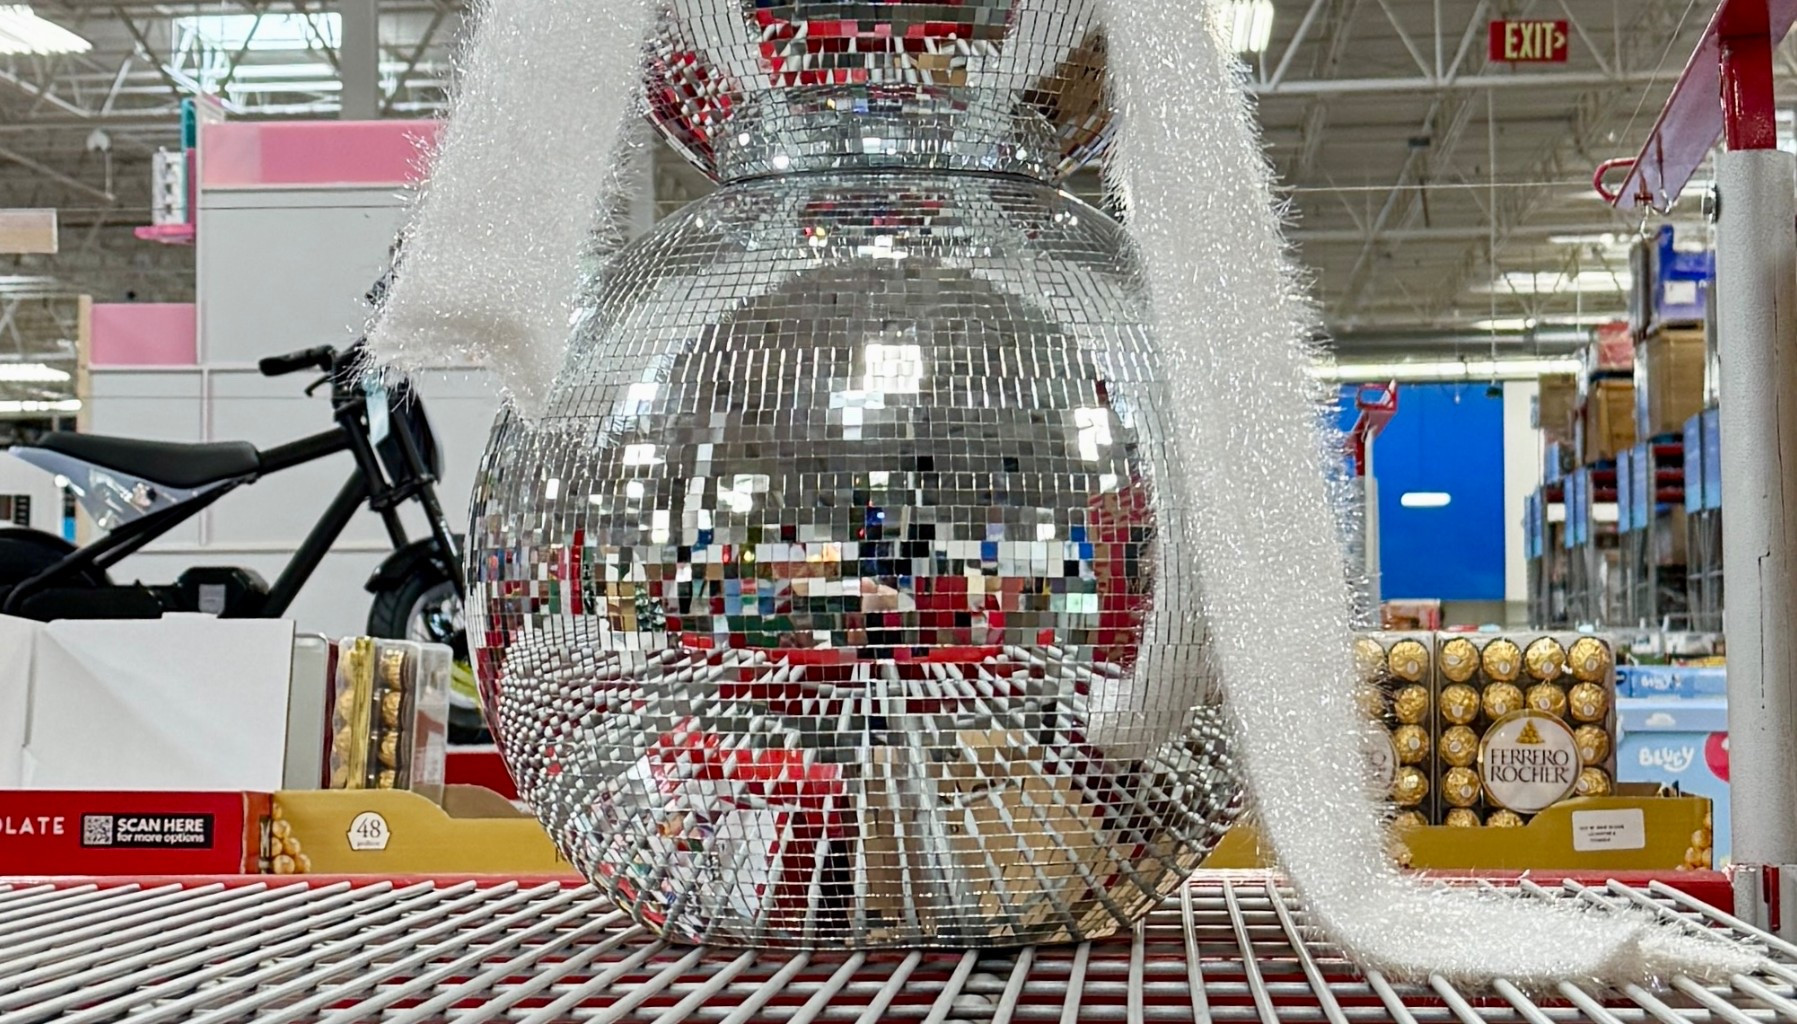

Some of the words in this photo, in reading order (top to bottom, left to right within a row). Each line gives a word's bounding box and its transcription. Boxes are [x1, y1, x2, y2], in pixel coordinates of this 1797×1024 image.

[1505, 22, 1555, 58] EXIT
[1490, 748, 1569, 766] FERRERO
[1490, 766, 1568, 784] ROCHER
[0, 816, 65, 835] LATE
[117, 818, 161, 832] SCAN
[163, 818, 204, 832] HERE
[356, 816, 381, 838] 48
[117, 832, 133, 842] for
[134, 833, 163, 842] more
[163, 832, 205, 845] options
